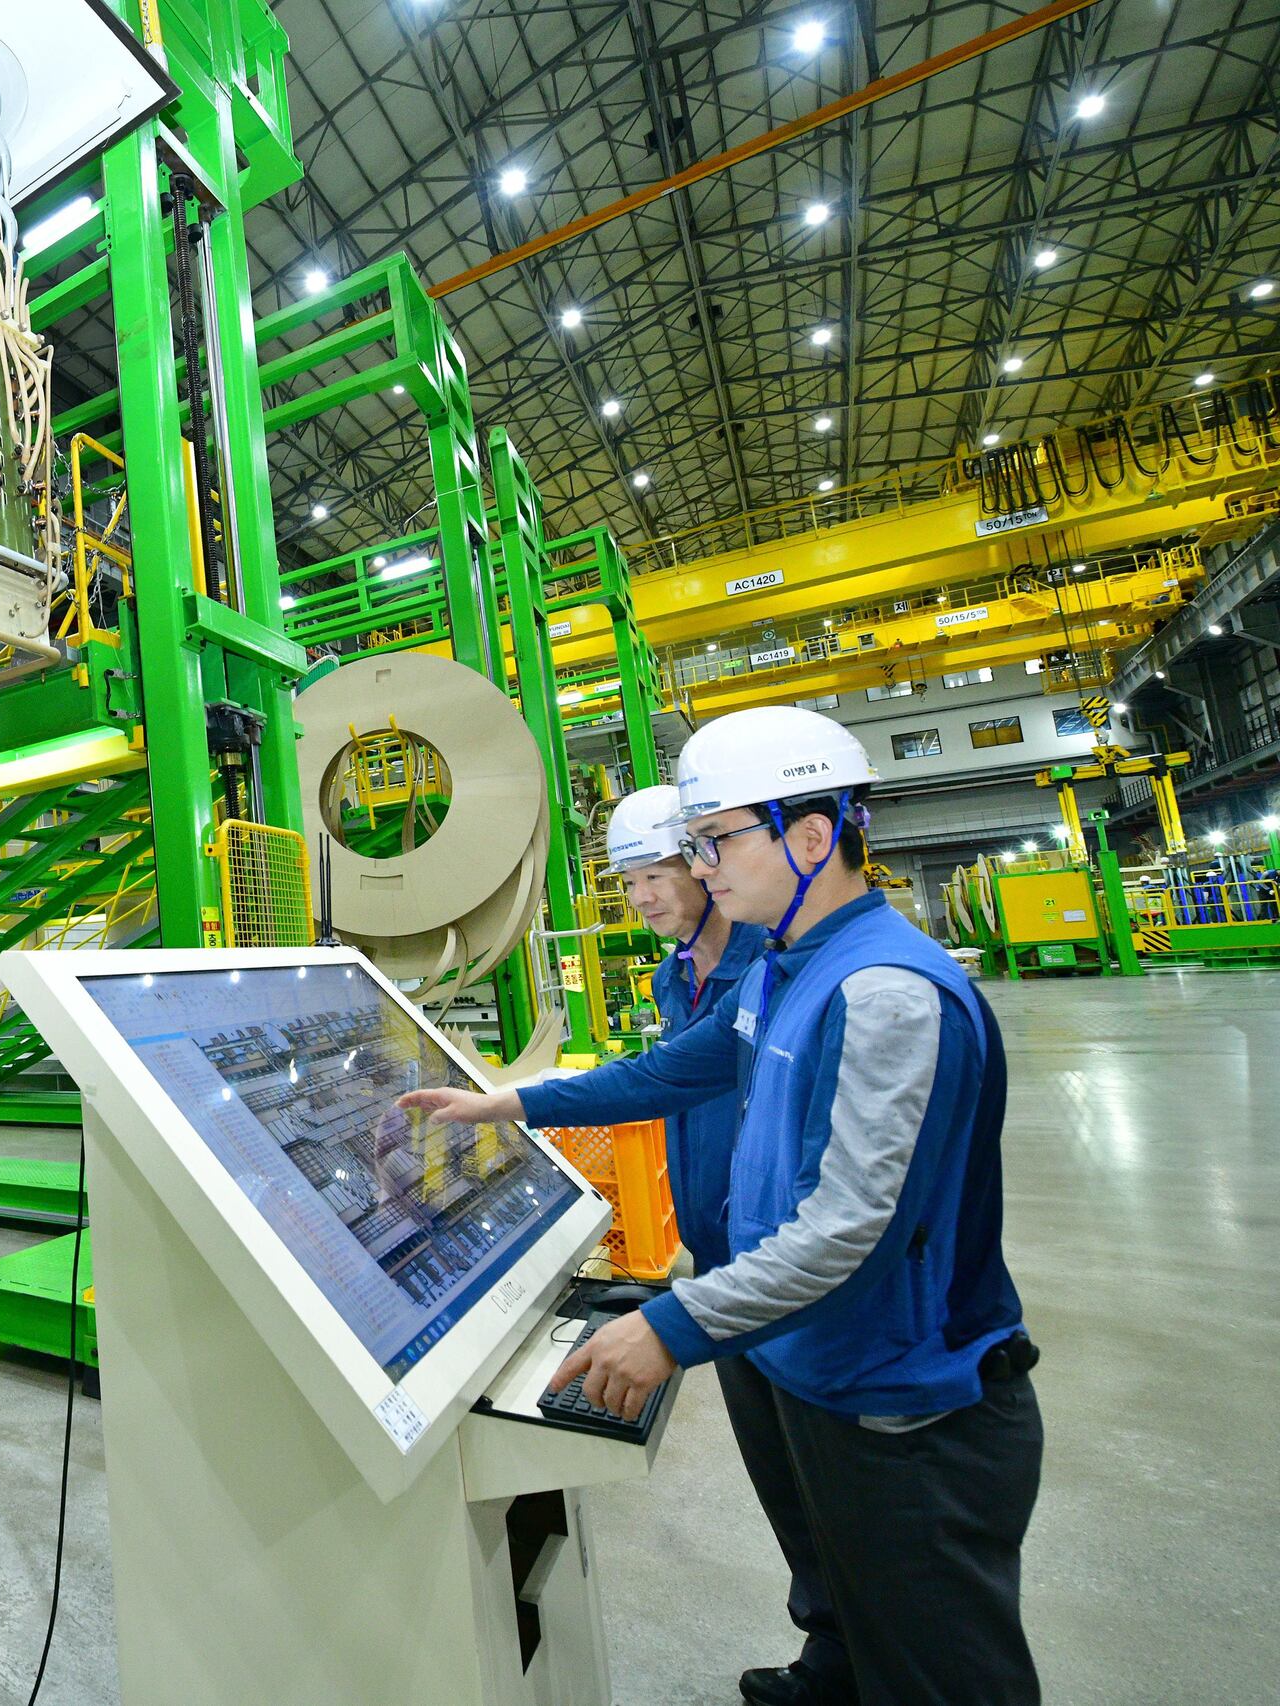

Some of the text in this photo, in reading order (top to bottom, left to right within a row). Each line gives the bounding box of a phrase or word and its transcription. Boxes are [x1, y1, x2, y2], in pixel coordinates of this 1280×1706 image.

[986, 512, 1037, 530] 50/15 TON
[734, 574, 776, 591] AC1420
[895, 601, 909, 612] 제
[938, 611, 977, 625] 50/15/5
[549, 622, 570, 632] YUNDAI
[757, 649, 789, 662] AC1419
[783, 762, 831, 778] 이병열 A
